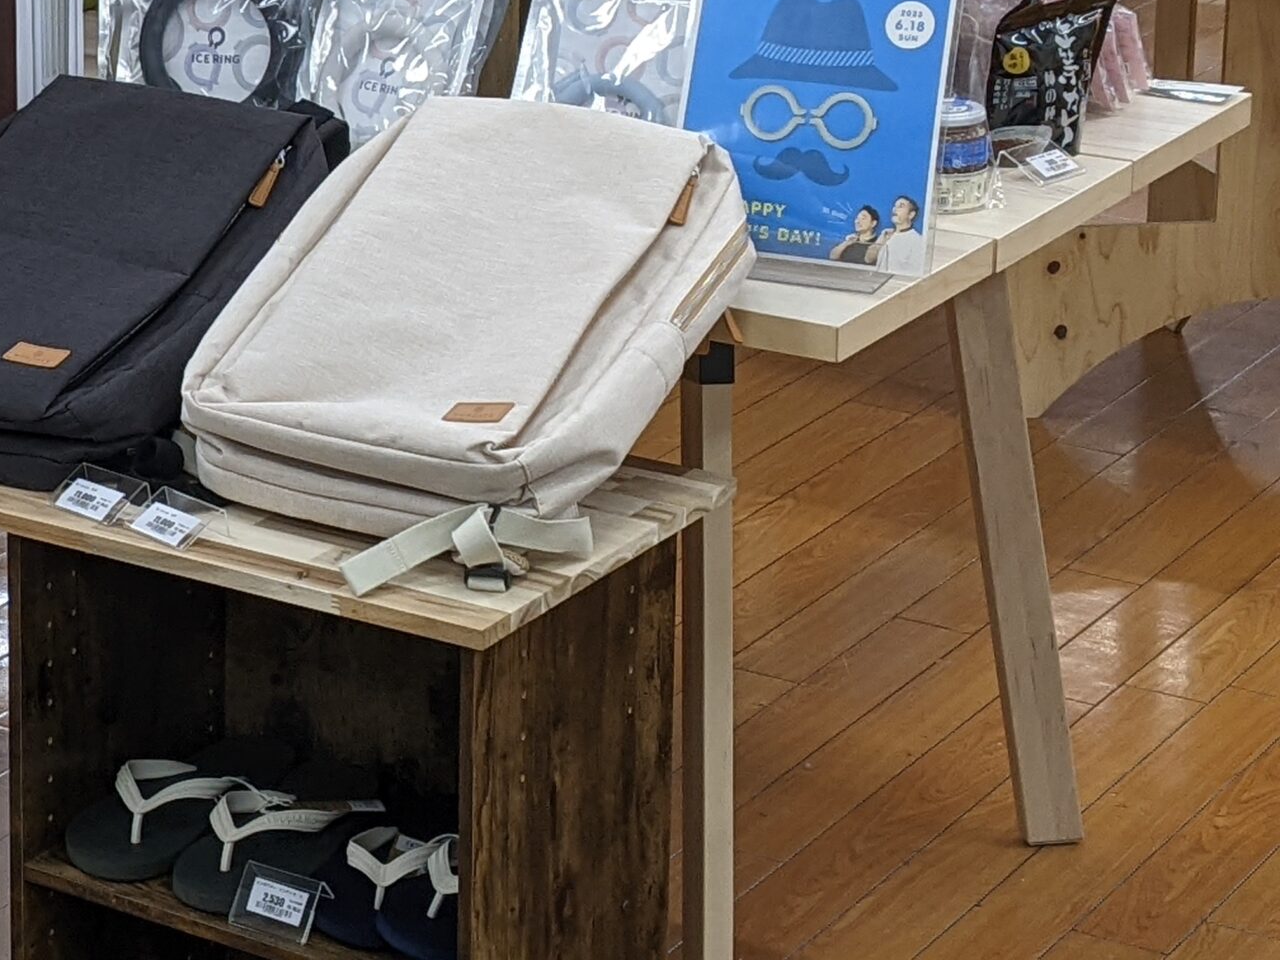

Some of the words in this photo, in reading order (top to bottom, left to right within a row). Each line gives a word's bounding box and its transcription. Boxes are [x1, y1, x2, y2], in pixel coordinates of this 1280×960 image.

[894, 19, 926, 33] 6.18
[897, 34, 919, 42] SUN
[191, 53, 211, 64] ICE
[212, 54, 241, 65] RING
[359, 80, 379, 92] ICE
